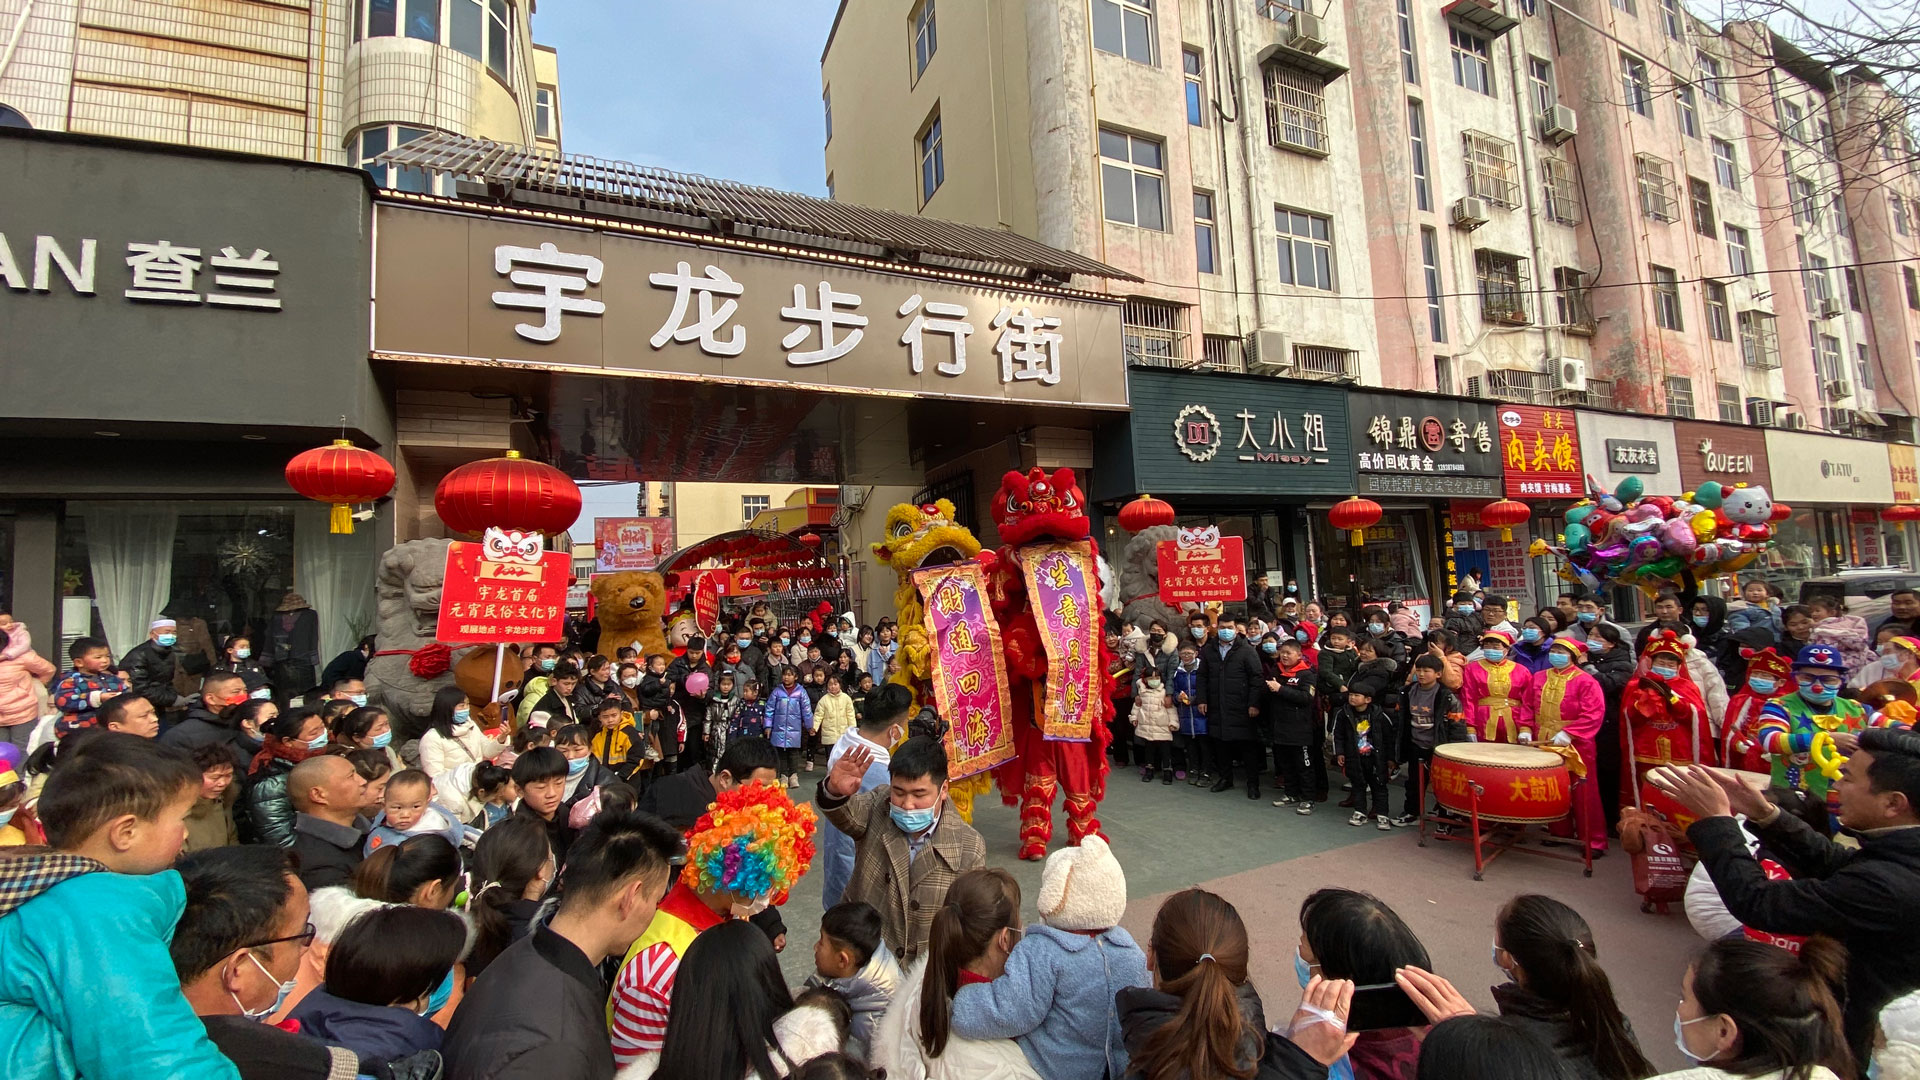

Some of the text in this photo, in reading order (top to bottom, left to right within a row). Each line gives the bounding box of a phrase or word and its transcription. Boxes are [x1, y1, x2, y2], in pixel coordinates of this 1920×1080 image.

[125, 240, 281, 309] 查兰
[492, 242, 1064, 385] 宇龙步行街
[1236, 408, 1328, 451] 大小姐
[1256, 452, 1311, 464] Missy
[1506, 429, 1576, 472] 肉夹馍
[1615, 446, 1657, 465] 灰灰衣舍
[1358, 452, 1434, 471] 高价回收黄金
[1705, 452, 1753, 473] QUEEN
[1829, 462, 1852, 477] TATU
[1178, 564, 1221, 575] 宇龙首届
[1164, 575, 1239, 587] 元宵民俗文化节
[478, 585, 538, 602] 宇龙首届
[449, 602, 558, 620] 元宵民俗文化节
[1509, 776, 1561, 802] 大鼓队
